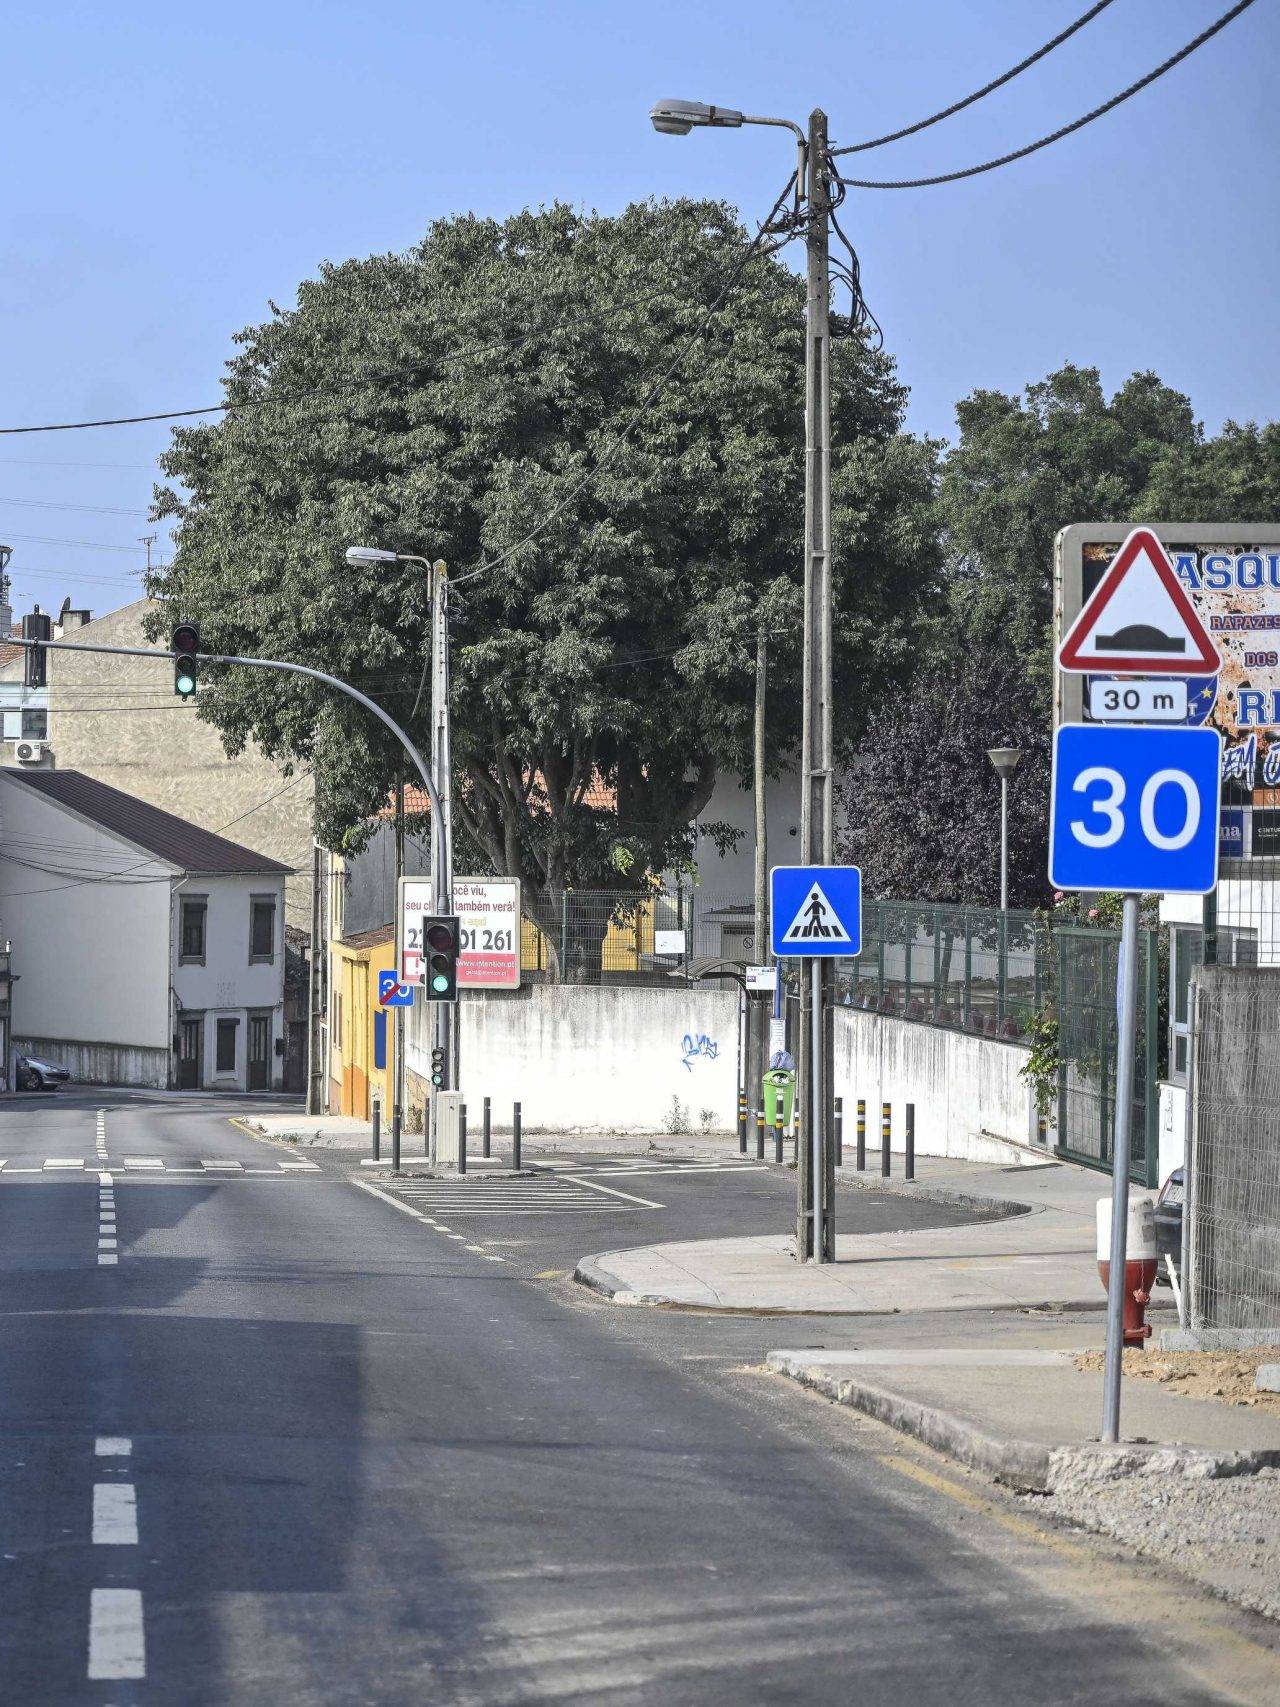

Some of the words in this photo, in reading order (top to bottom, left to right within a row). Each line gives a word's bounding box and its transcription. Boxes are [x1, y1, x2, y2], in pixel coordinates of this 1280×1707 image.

[1244, 651, 1278, 667] DOS
[1104, 689, 1140, 711] 30
[1153, 694, 1174, 710] m
[1069, 766, 1201, 851] 30
[453, 884, 469, 896] ocê
[405, 901, 421, 910] seu
[454, 900, 491, 912] também
[482, 929, 512, 951] 261
